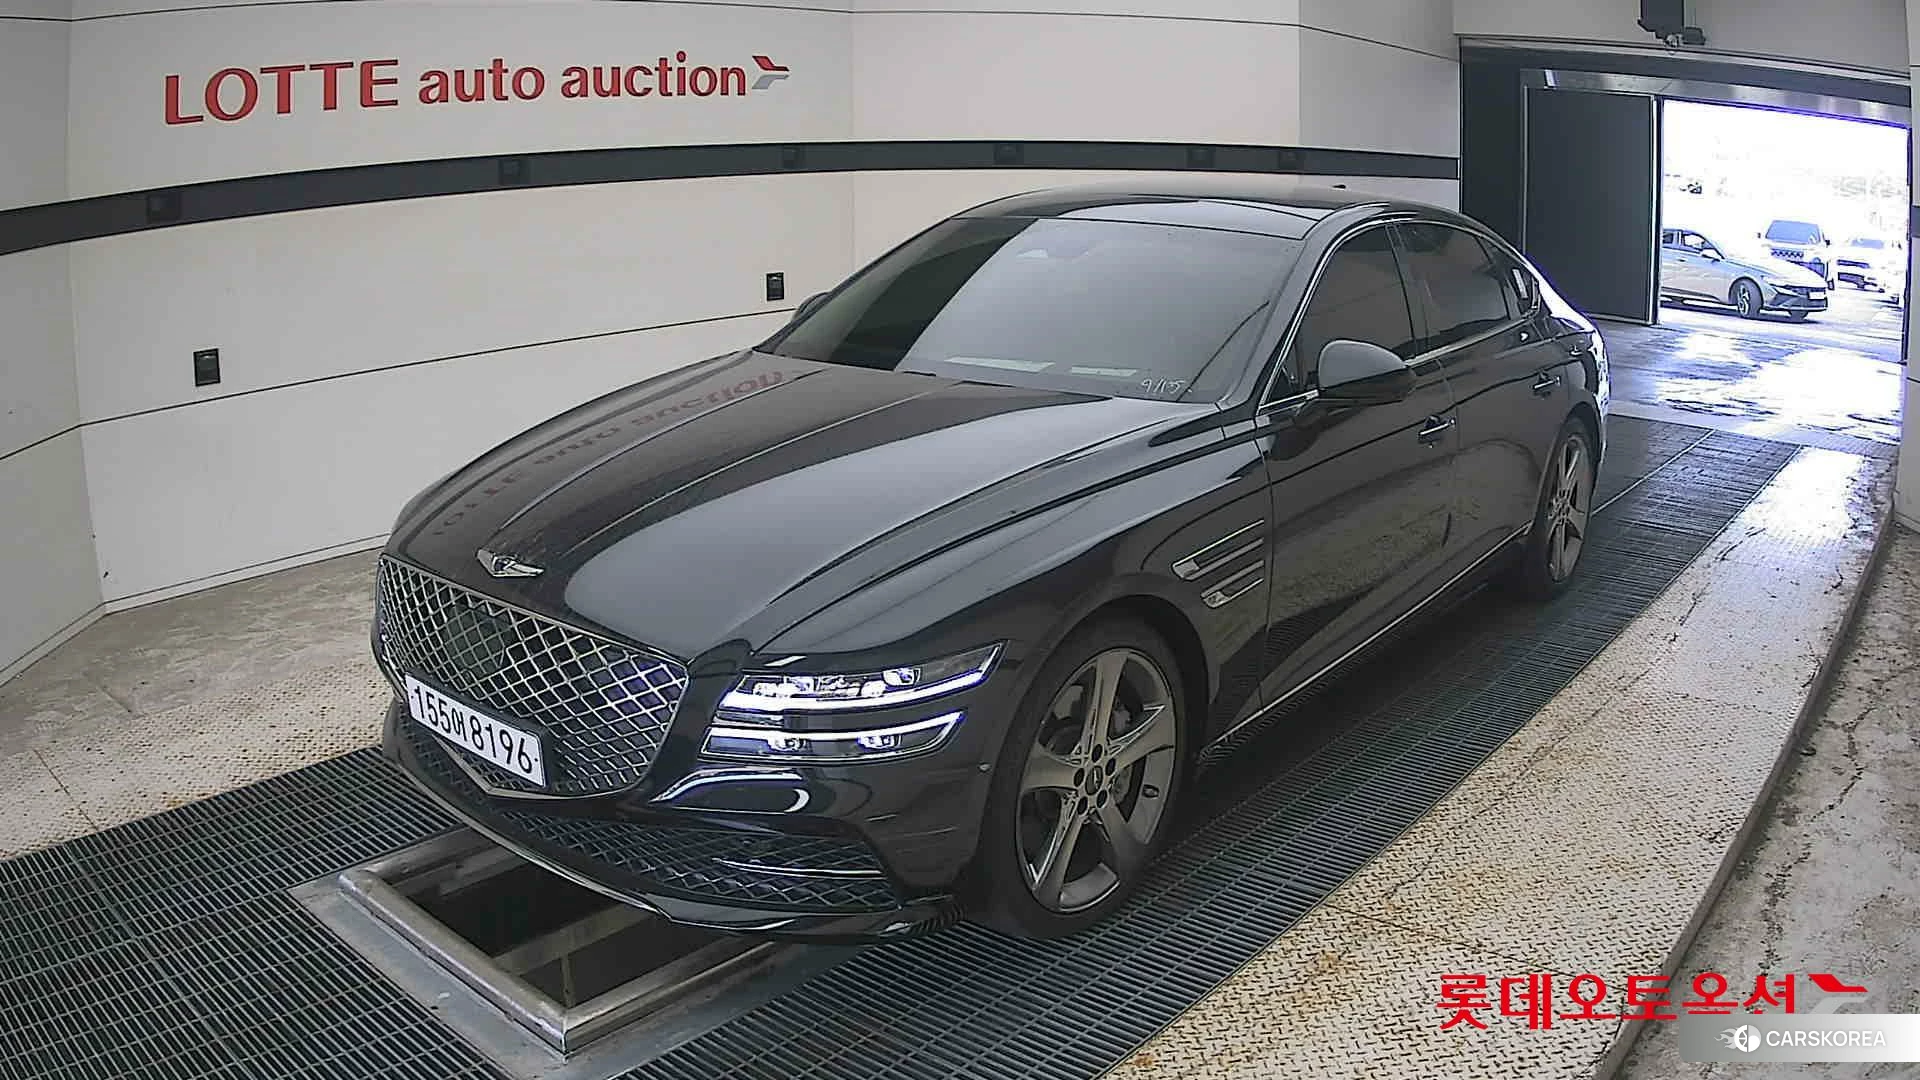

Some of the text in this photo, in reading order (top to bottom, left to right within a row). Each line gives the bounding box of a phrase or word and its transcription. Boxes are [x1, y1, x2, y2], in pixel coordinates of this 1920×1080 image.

[164, 51, 748, 125] LOTTE auto auction
